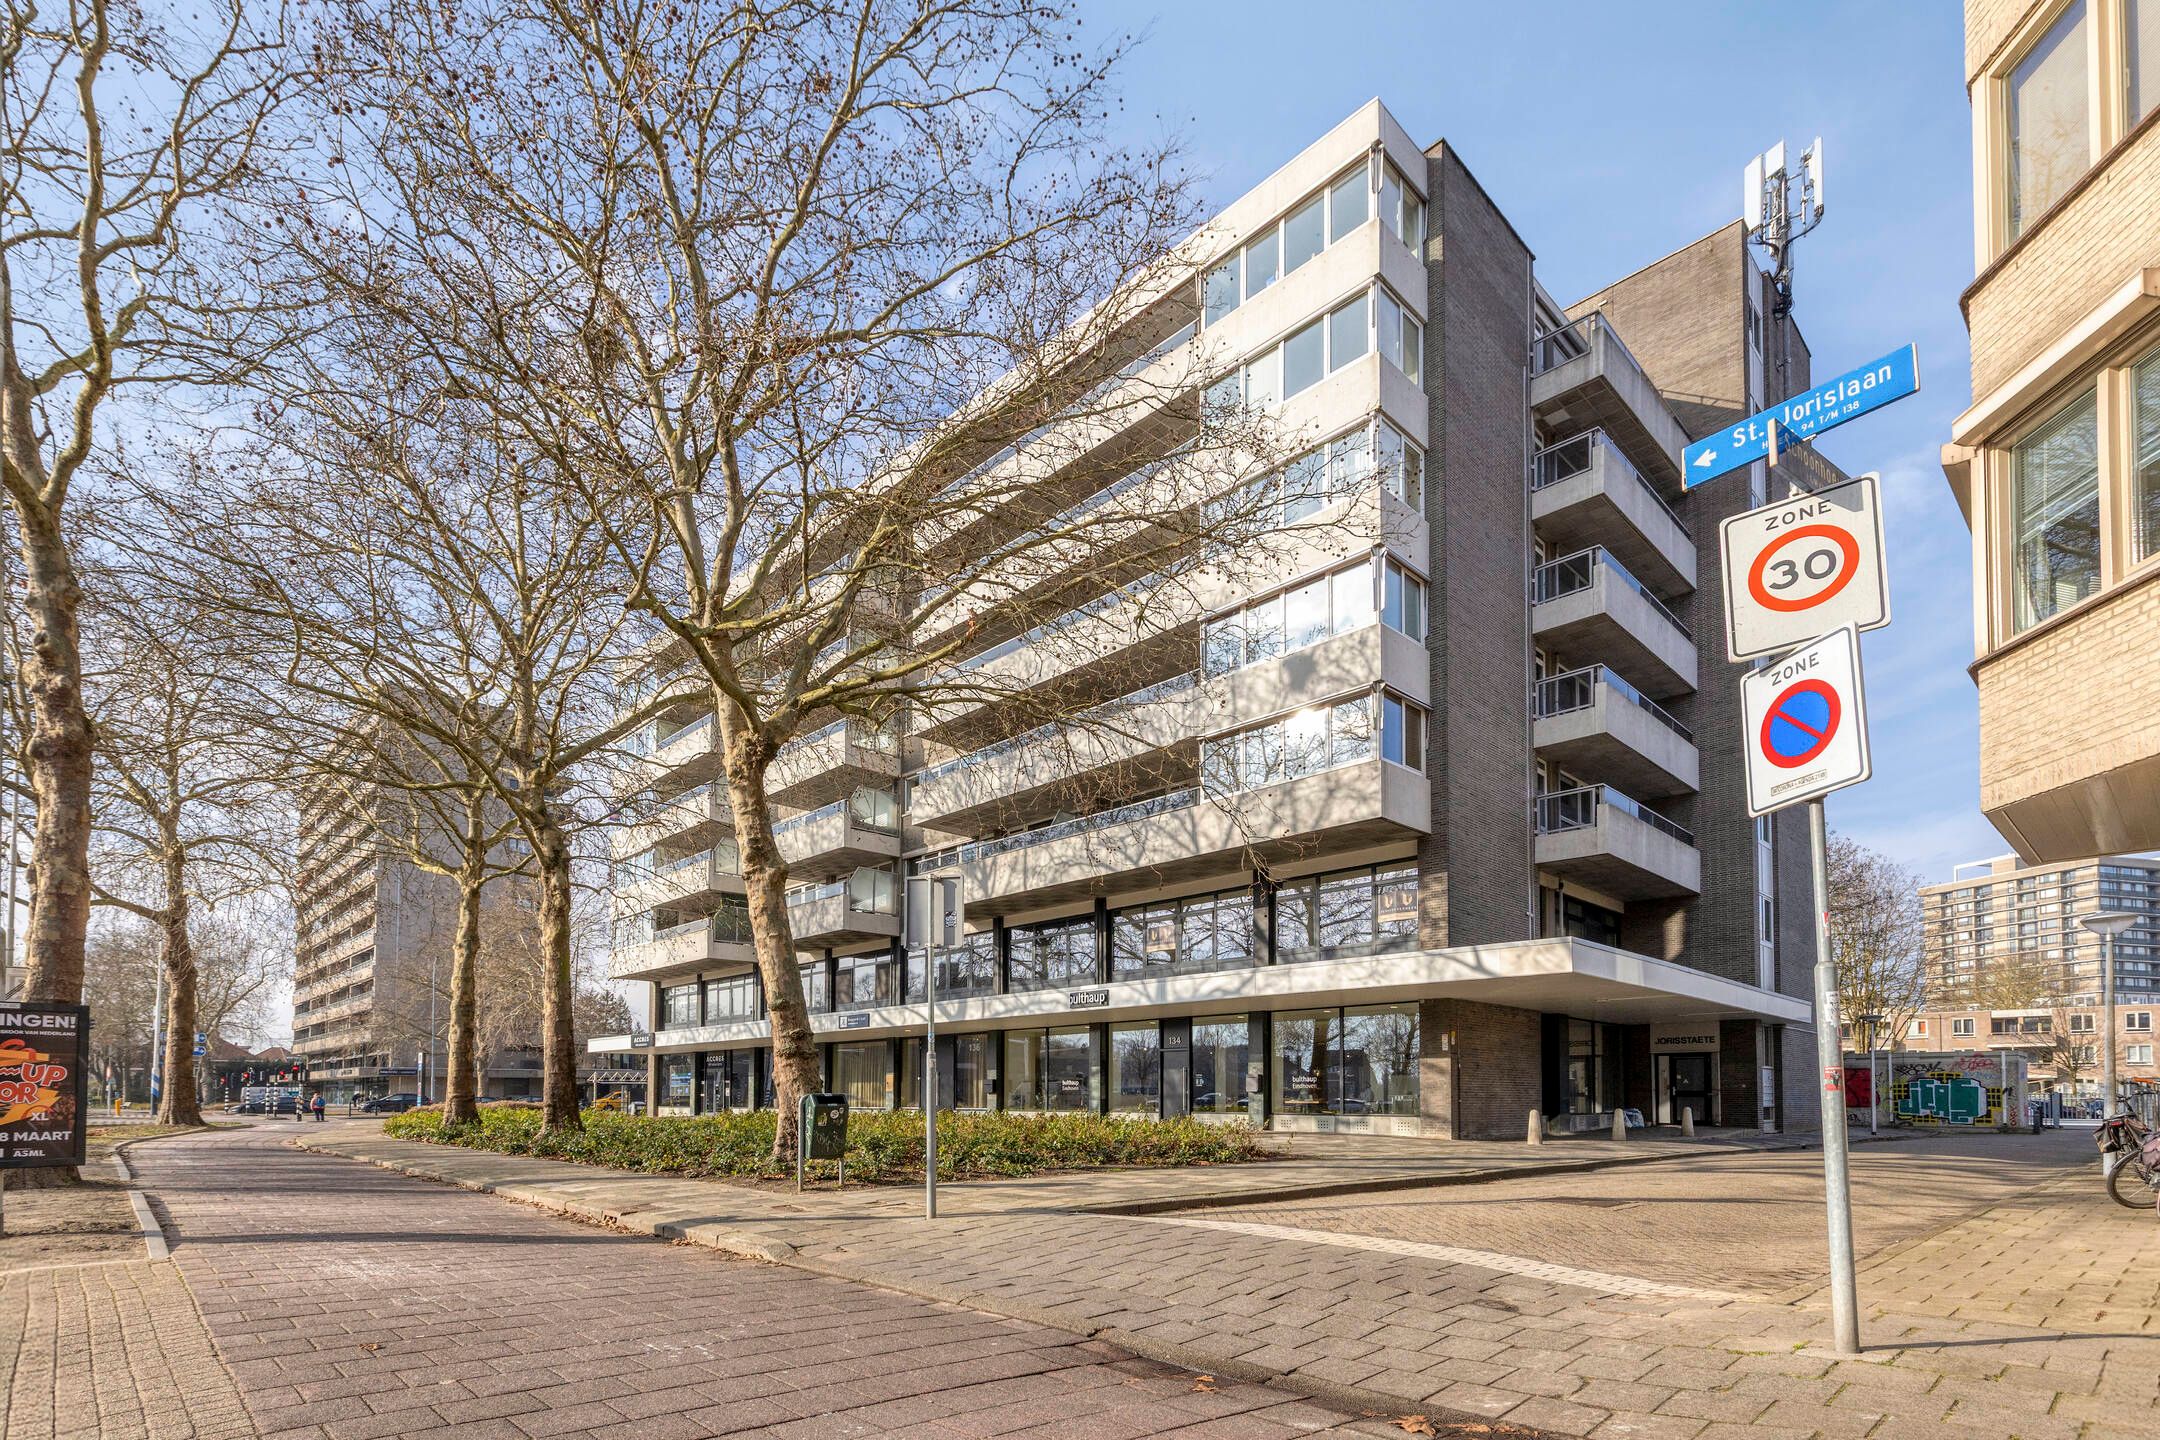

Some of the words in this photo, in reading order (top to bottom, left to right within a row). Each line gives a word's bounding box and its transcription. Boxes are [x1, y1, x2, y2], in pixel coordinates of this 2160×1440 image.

[1733, 421, 1765, 448] St.
[1782, 365, 1892, 426] Jorislaan
[1801, 421, 1815, 432] 94
[1818, 409, 1839, 424] T/M
[1842, 400, 1860, 414] 138
[1784, 432, 1840, 485] Schoonhoe
[1765, 499, 1832, 531] ZONE
[1768, 549, 1837, 590] 30
[1771, 652, 1820, 686] ZONE
[0, 1013, 76, 1029] INGEN!
[1169, 1036, 1182, 1045] 134
[1654, 1035, 1716, 1045] JORISSTAETE
[30, 1112, 50, 1121] XL
[13, 1130, 73, 1142] MAART
[13, 1148, 46, 1157] ASML
